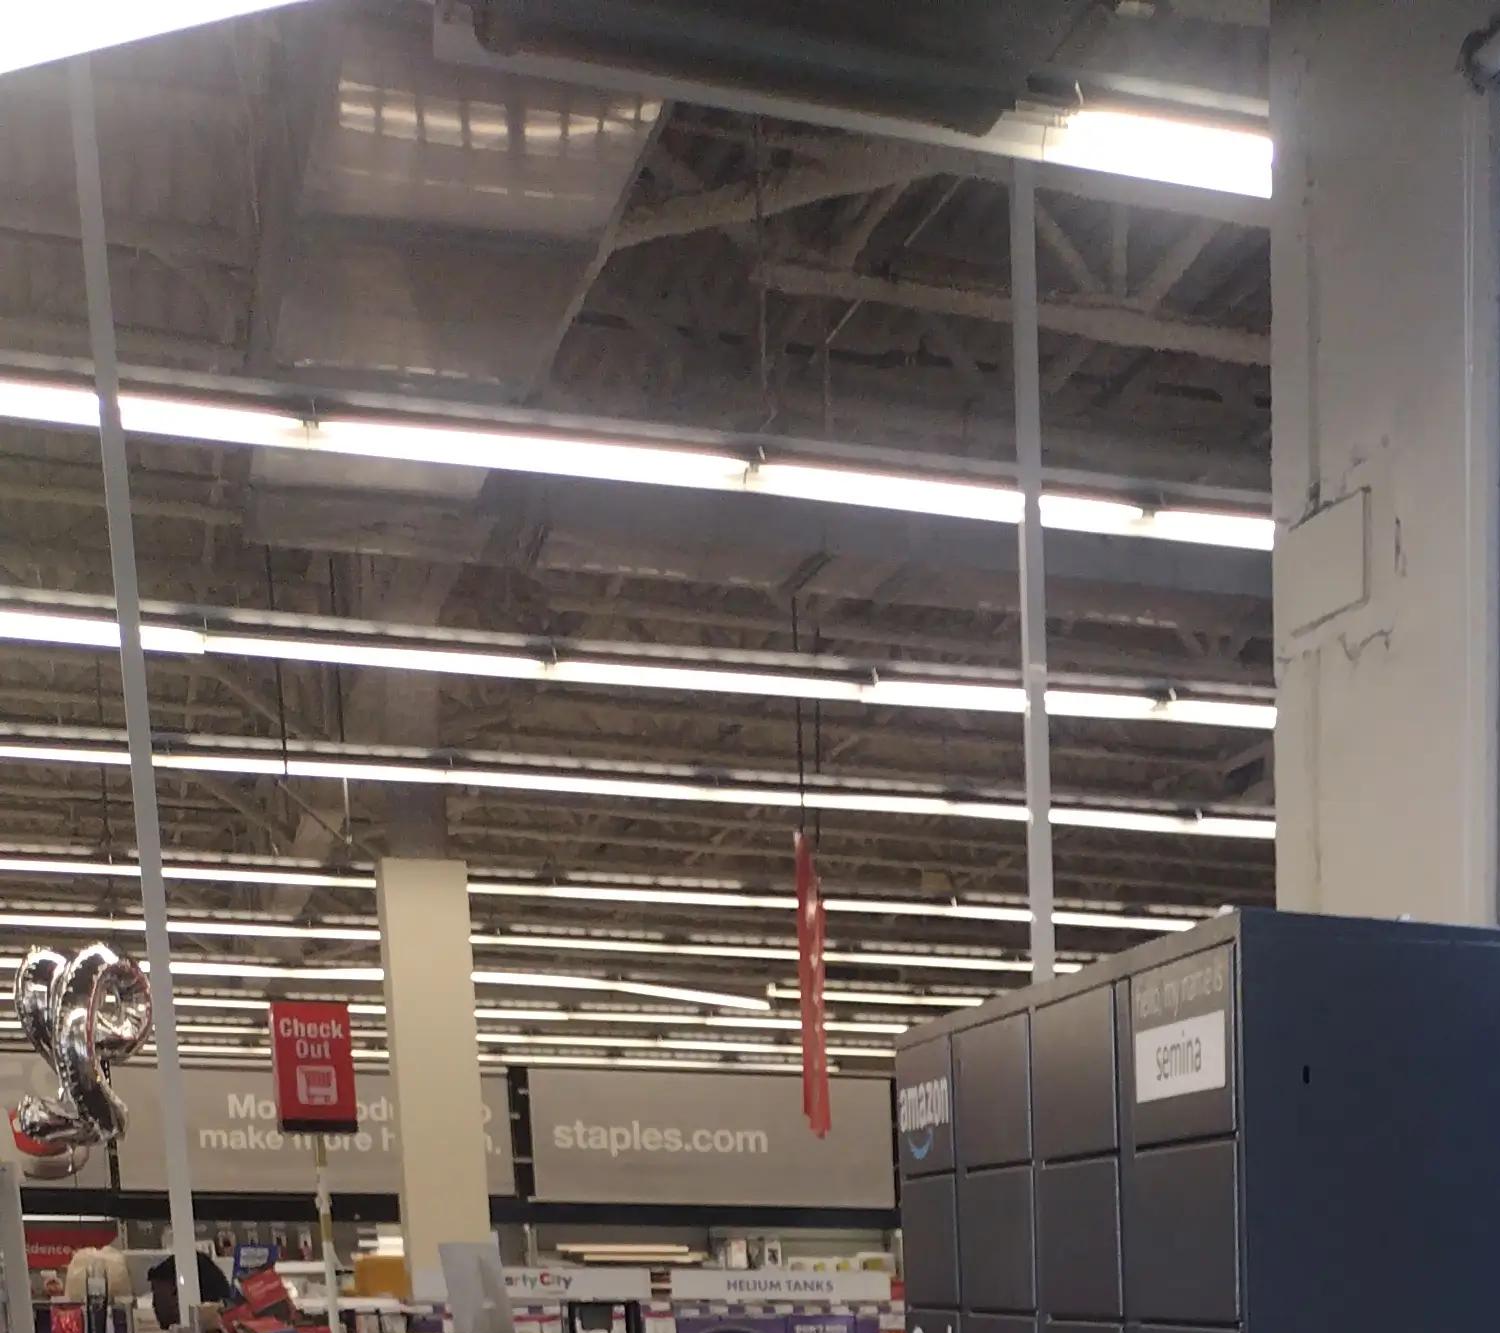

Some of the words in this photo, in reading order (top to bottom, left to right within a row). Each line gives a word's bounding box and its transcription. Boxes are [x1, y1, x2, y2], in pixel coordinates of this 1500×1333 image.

[280, 1018, 344, 1039] Check
[296, 1039, 331, 1059] Out
[1156, 1029, 1202, 1081] semina
[228, 1093, 277, 1120] Mo
[900, 1077, 949, 1133] amazon
[199, 1125, 283, 1150] make
[553, 1120, 769, 1158] staples.com
[726, 1279, 782, 1293] HELIUM
[786, 1280, 834, 1293] TANKS
